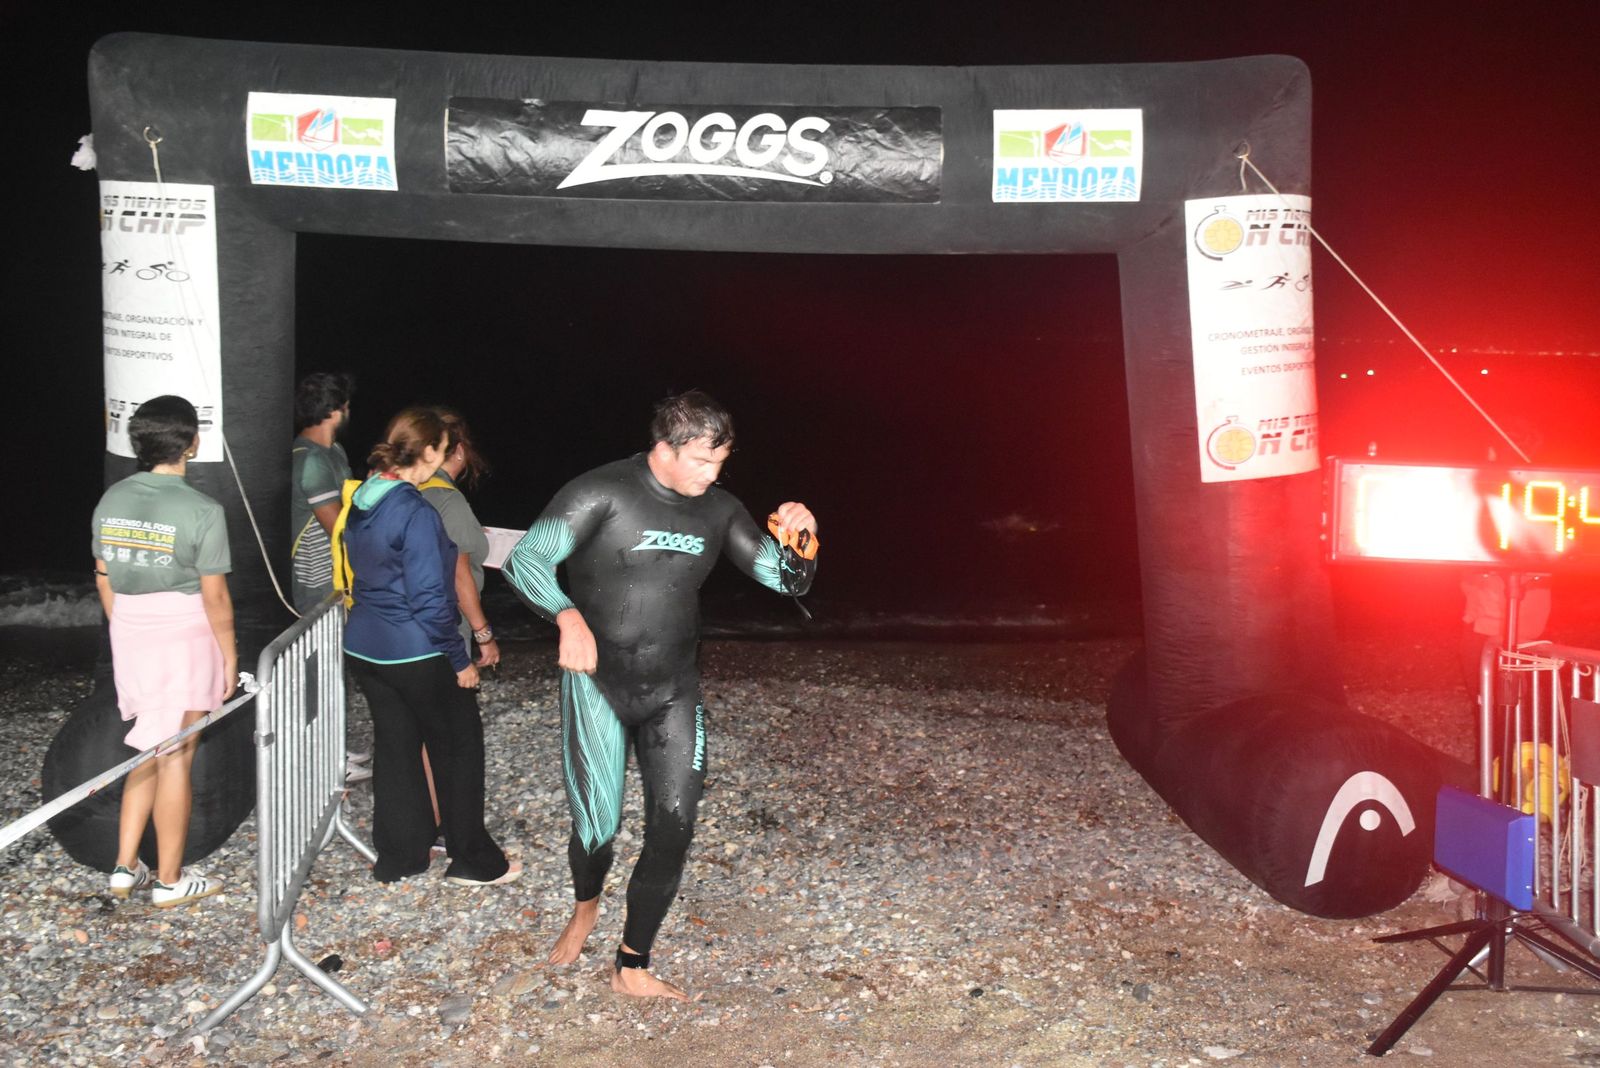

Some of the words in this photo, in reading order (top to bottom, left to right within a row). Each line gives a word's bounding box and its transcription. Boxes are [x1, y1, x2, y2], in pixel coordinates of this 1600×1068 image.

[556, 109, 831, 189] ZOGGS
[251, 150, 394, 186] MENDOZA
[996, 166, 1137, 199] MENDOZA
[1246, 209, 1279, 221] MIS
[160, 332, 173, 341] DE
[122, 349, 174, 361] DEPORTIVOS
[1241, 363, 1281, 376] EVENTOS
[1258, 416, 1289, 431] MIS
[106, 517, 142, 528] ASCENSO
[142, 521, 153, 529] AL
[153, 522, 176, 533] FOSO
[131, 530, 148, 540] DEL
[148, 532, 175, 544] PILAR
[631, 530, 705, 556] ZOGGS
